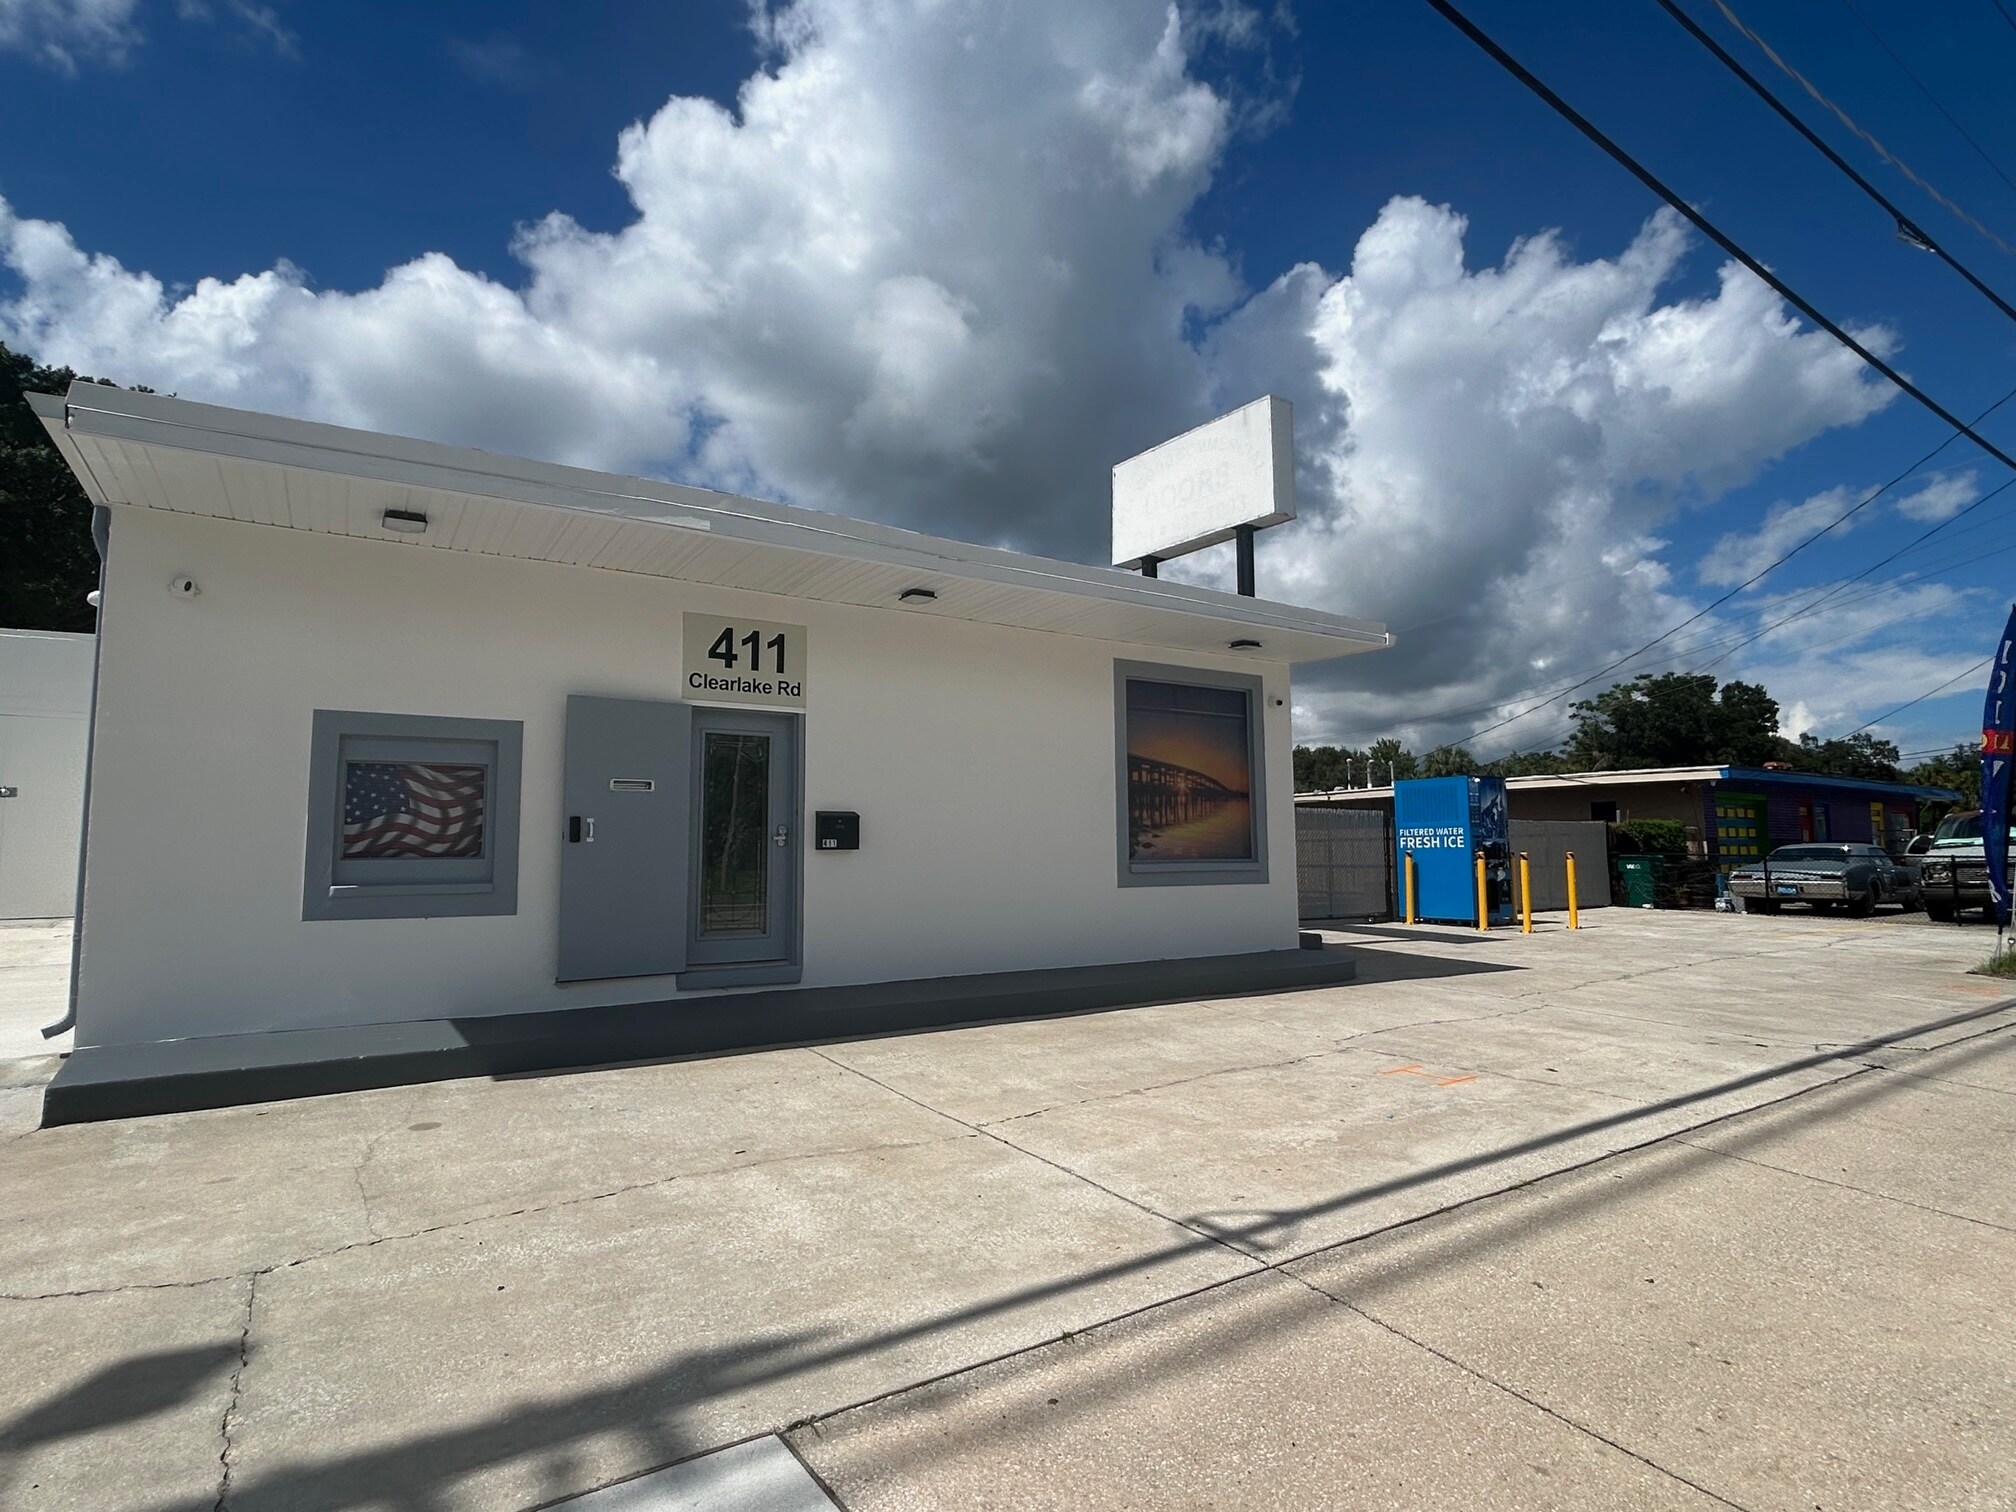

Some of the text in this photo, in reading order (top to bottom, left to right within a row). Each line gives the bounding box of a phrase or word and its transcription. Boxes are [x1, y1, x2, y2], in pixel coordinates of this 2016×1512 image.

[707, 627, 785, 674] 411
[688, 672, 801, 697] Clearlake Rd
[1435, 827, 1464, 835] WATER
[1400, 836, 1465, 848] FRESH ICE
